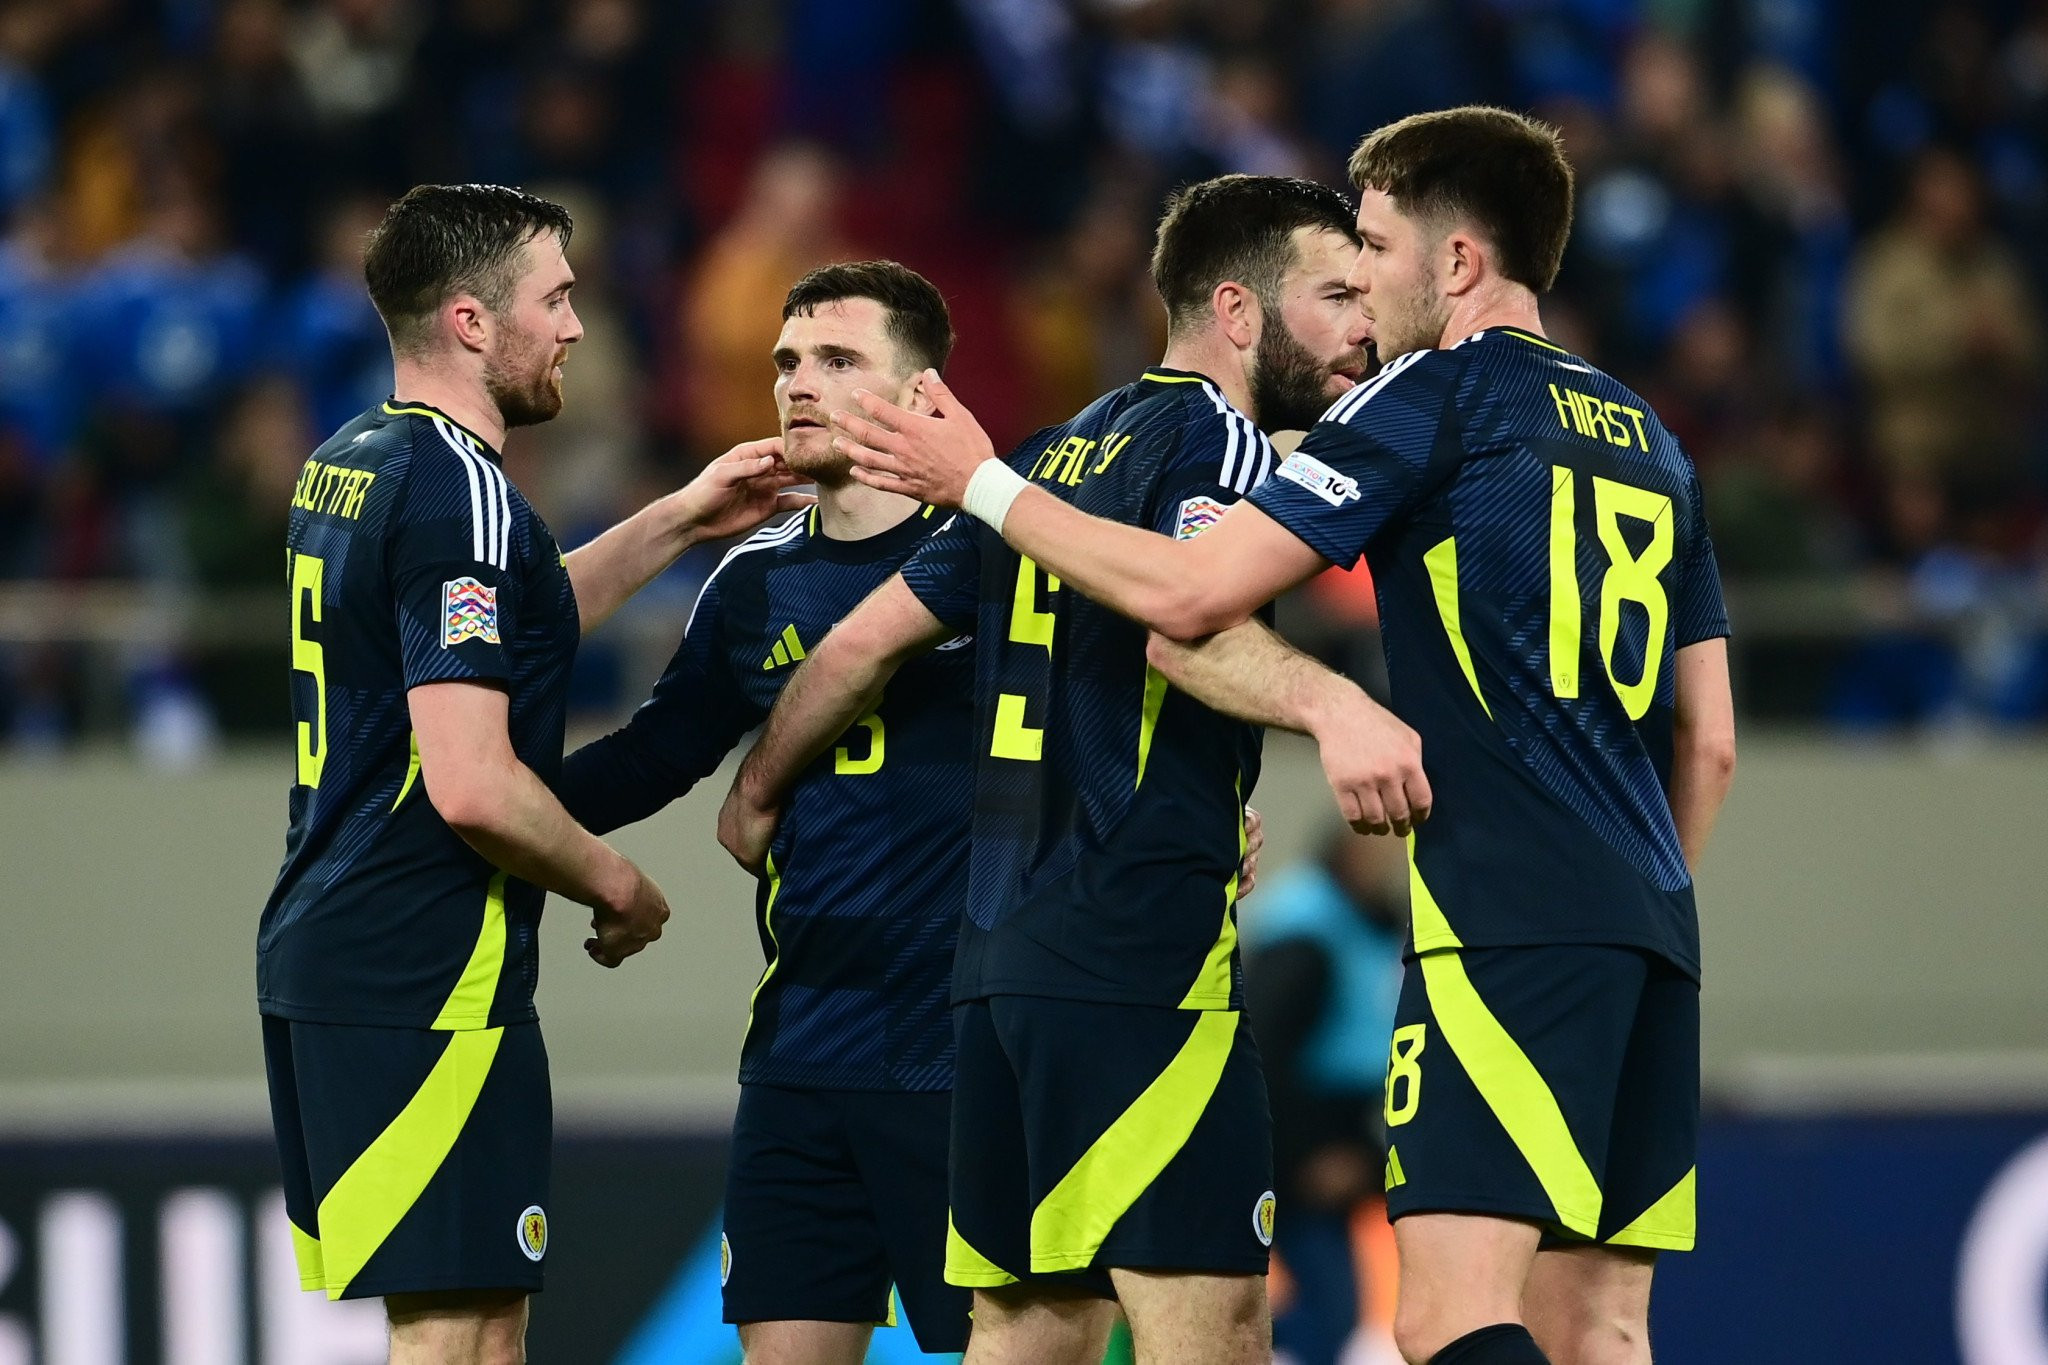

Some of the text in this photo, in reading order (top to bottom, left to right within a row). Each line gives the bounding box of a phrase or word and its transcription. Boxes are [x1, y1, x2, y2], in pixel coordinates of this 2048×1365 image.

[1548, 383, 1649, 452] HIRST
[286, 547, 328, 790] 5
[1549, 464, 1674, 721] 18
[1383, 1023, 1427, 1128] 8
